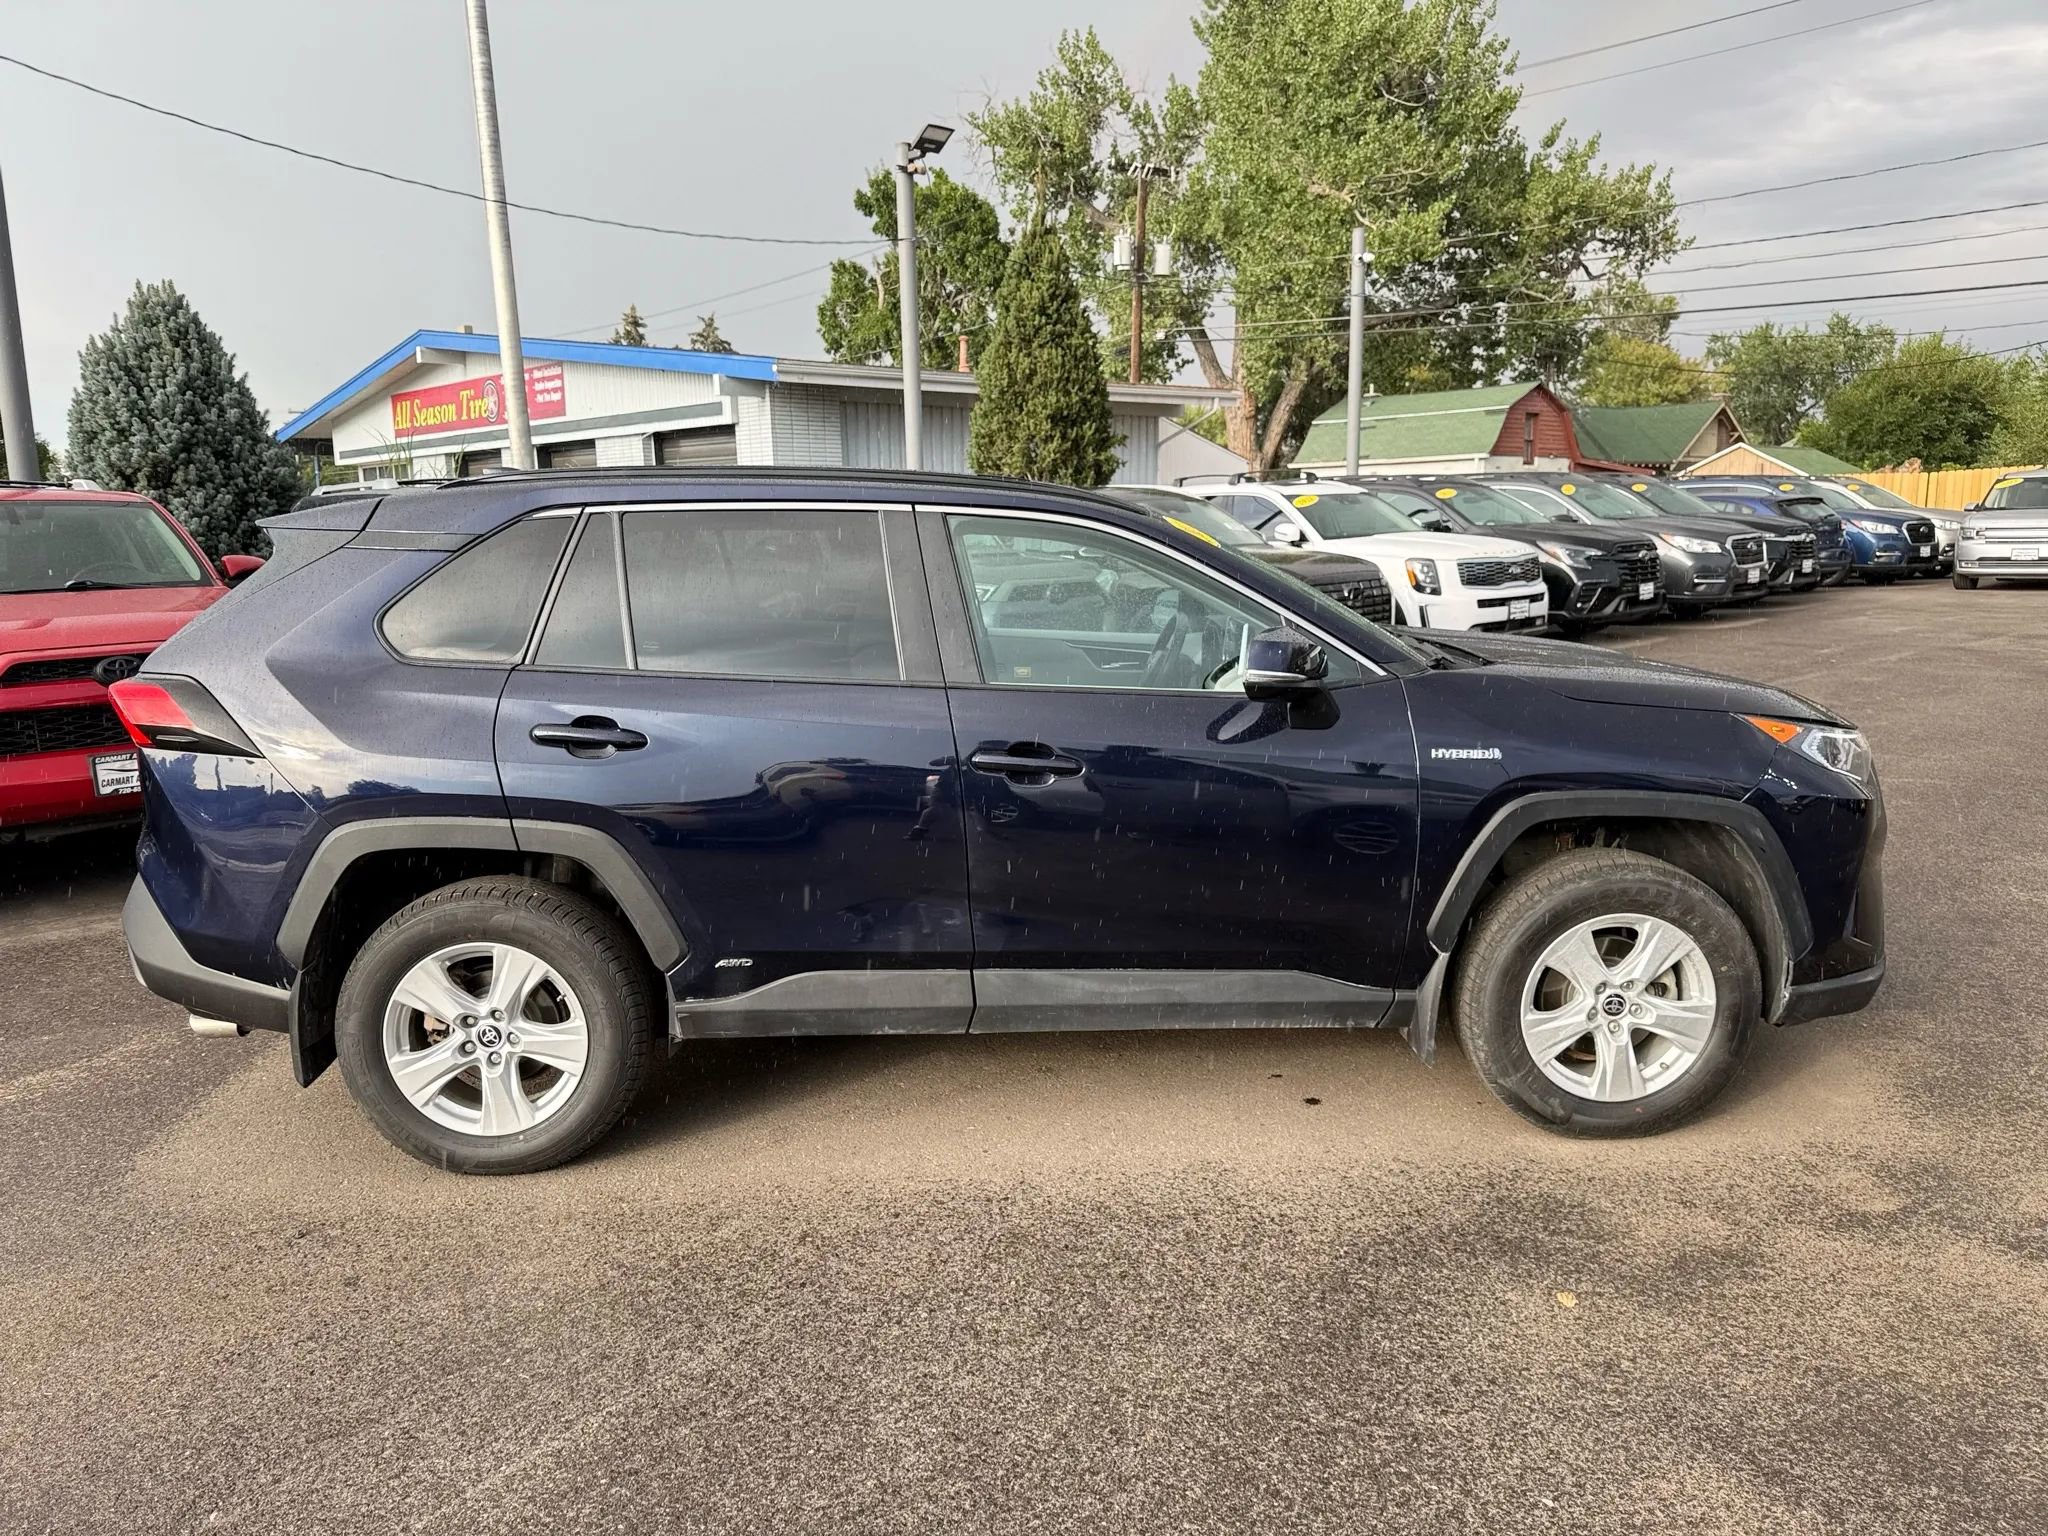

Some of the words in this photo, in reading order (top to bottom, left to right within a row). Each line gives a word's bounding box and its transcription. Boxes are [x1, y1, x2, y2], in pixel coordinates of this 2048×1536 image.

[394, 400, 411, 430] All
[413, 399, 457, 428] Season
[460, 390, 489, 420] Tire
[95, 754, 131, 763] CARMART
[1431, 748, 1489, 759] HYBRID
[101, 776, 134, 788] CARMART
[714, 958, 754, 969] AWD
